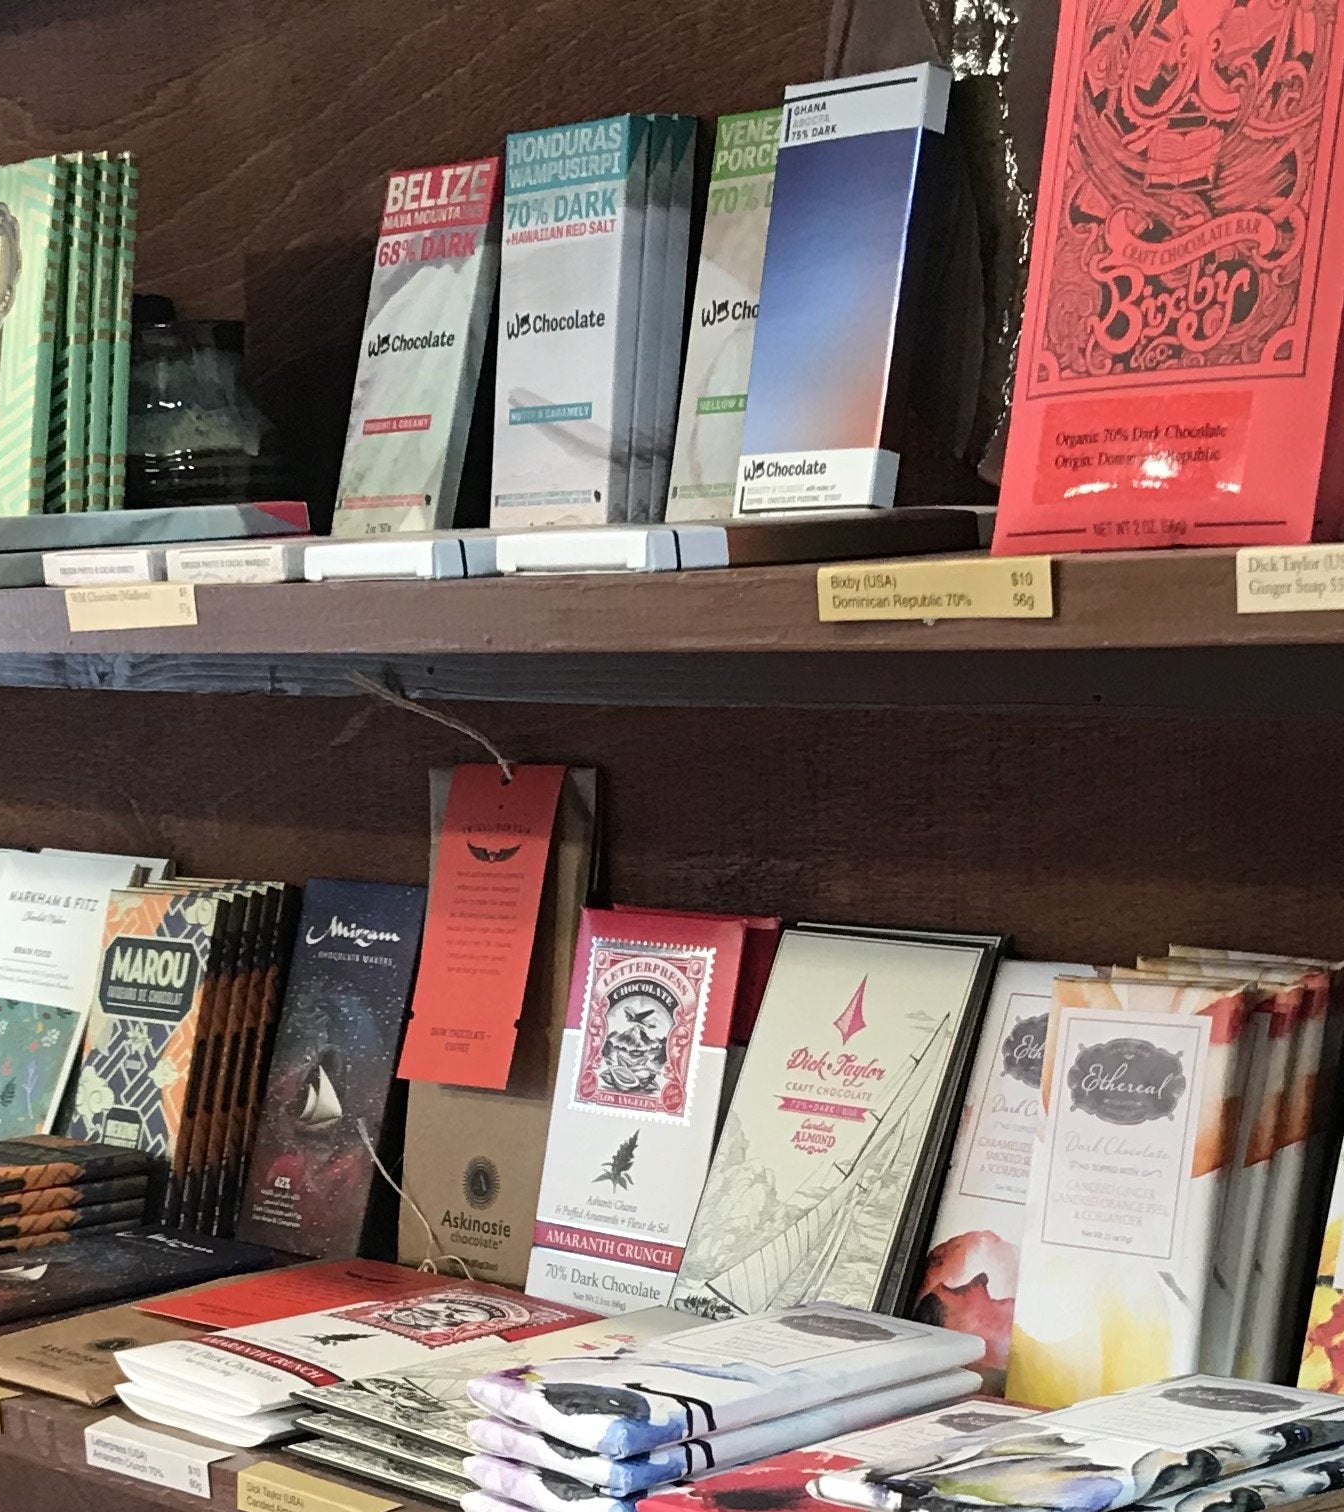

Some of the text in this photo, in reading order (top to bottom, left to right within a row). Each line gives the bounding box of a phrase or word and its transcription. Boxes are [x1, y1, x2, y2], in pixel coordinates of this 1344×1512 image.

[794, 101, 826, 116] GHANA
[509, 122, 623, 165] HONDURAS
[509, 151, 621, 188] WAMPUSIRPI
[386, 164, 491, 214] BELIZE
[507, 188, 616, 230] 70% DARK
[378, 232, 477, 267] 68% DARK
[1090, 262, 1253, 356] Bixby
[391, 330, 455, 352] Chocolate
[1132, 425, 1160, 441] Dark
[1164, 422, 1228, 440] Chocolate
[766, 459, 827, 478] Chocolate
[830, 571, 1034, 593] Bixby (USA) $10
[1247, 556, 1276, 573] Dick
[1277, 555, 1321, 575] Taylor
[832, 593, 891, 610] Dominican
[893, 592, 943, 611] Republic
[945, 592, 973, 608] 70%
[110, 946, 191, 989] MAROU
[603, 961, 689, 997] LETTERPRESS
[612, 982, 674, 1007] CHOCOLATE
[832, 1053, 887, 1087] Taylor
[1081, 1062, 1174, 1100] Ethereal
[784, 1081, 873, 1101] CRAFT CHOCOLATE
[790, 1131, 837, 1149] ALMOND
[441, 1209, 511, 1238] Askinosie
[545, 1229, 673, 1265] AMARANTH CRUNCH
[544, 1263, 661, 1300] 70% Dark Chocolate
